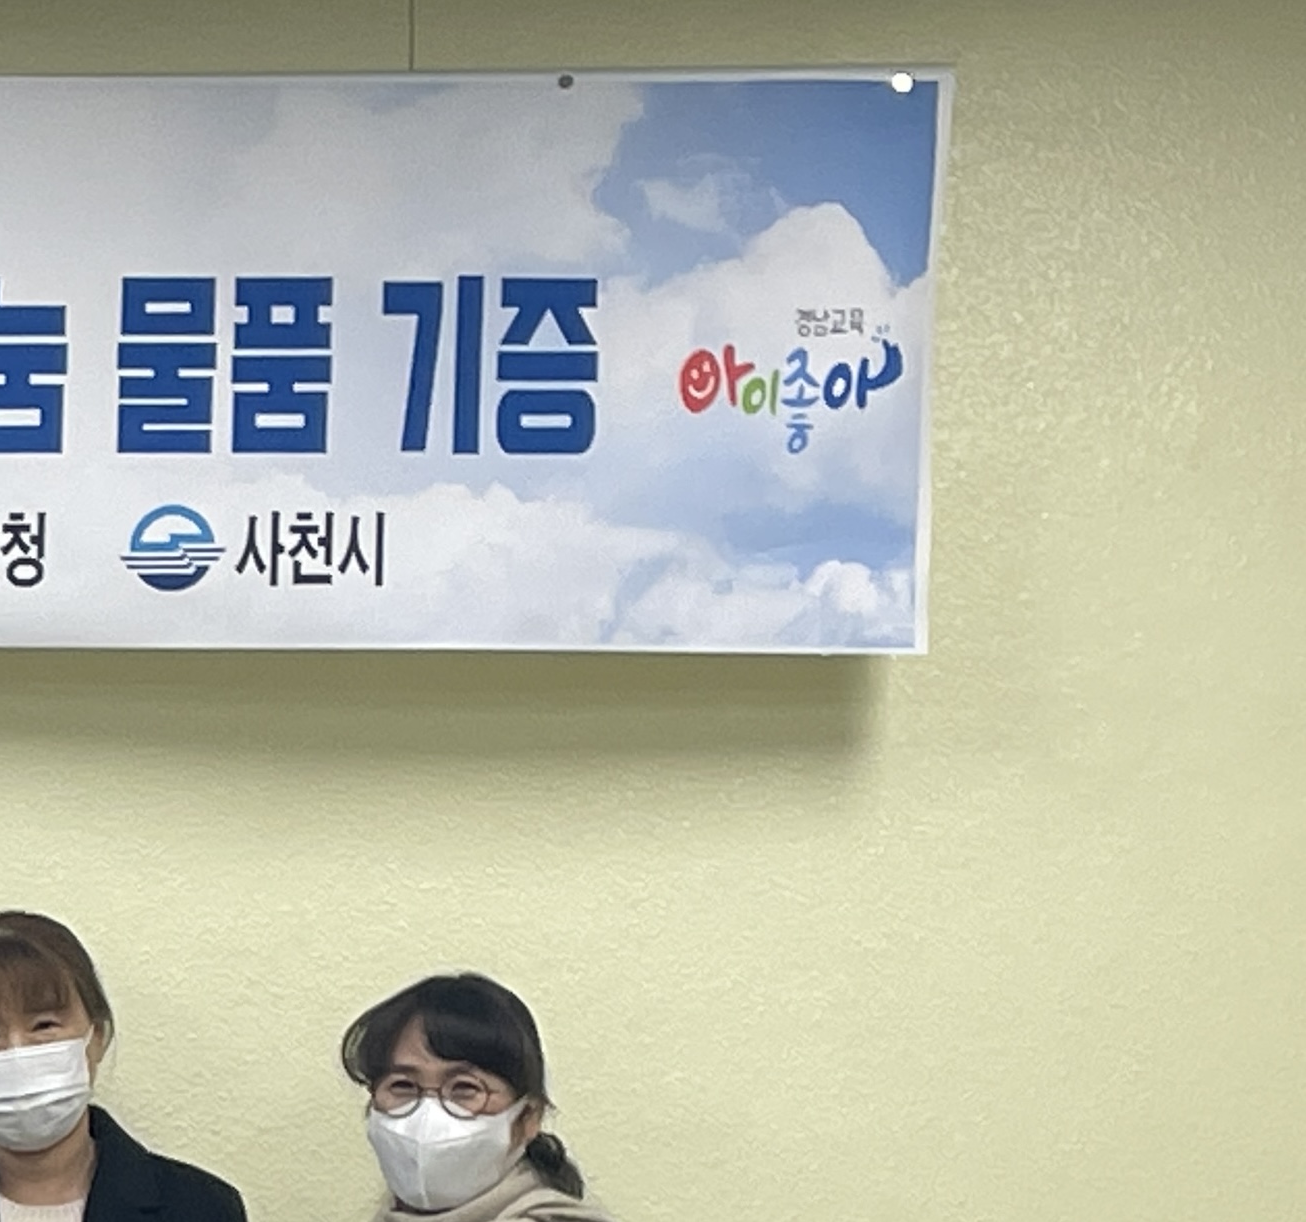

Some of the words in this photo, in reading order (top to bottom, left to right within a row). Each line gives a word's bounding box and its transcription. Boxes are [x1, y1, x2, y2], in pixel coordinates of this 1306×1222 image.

[795, 307, 865, 337] 경남교육
[117, 277, 331, 454] 물품
[382, 275, 597, 455] 기증
[234, 510, 386, 588] 사천시
